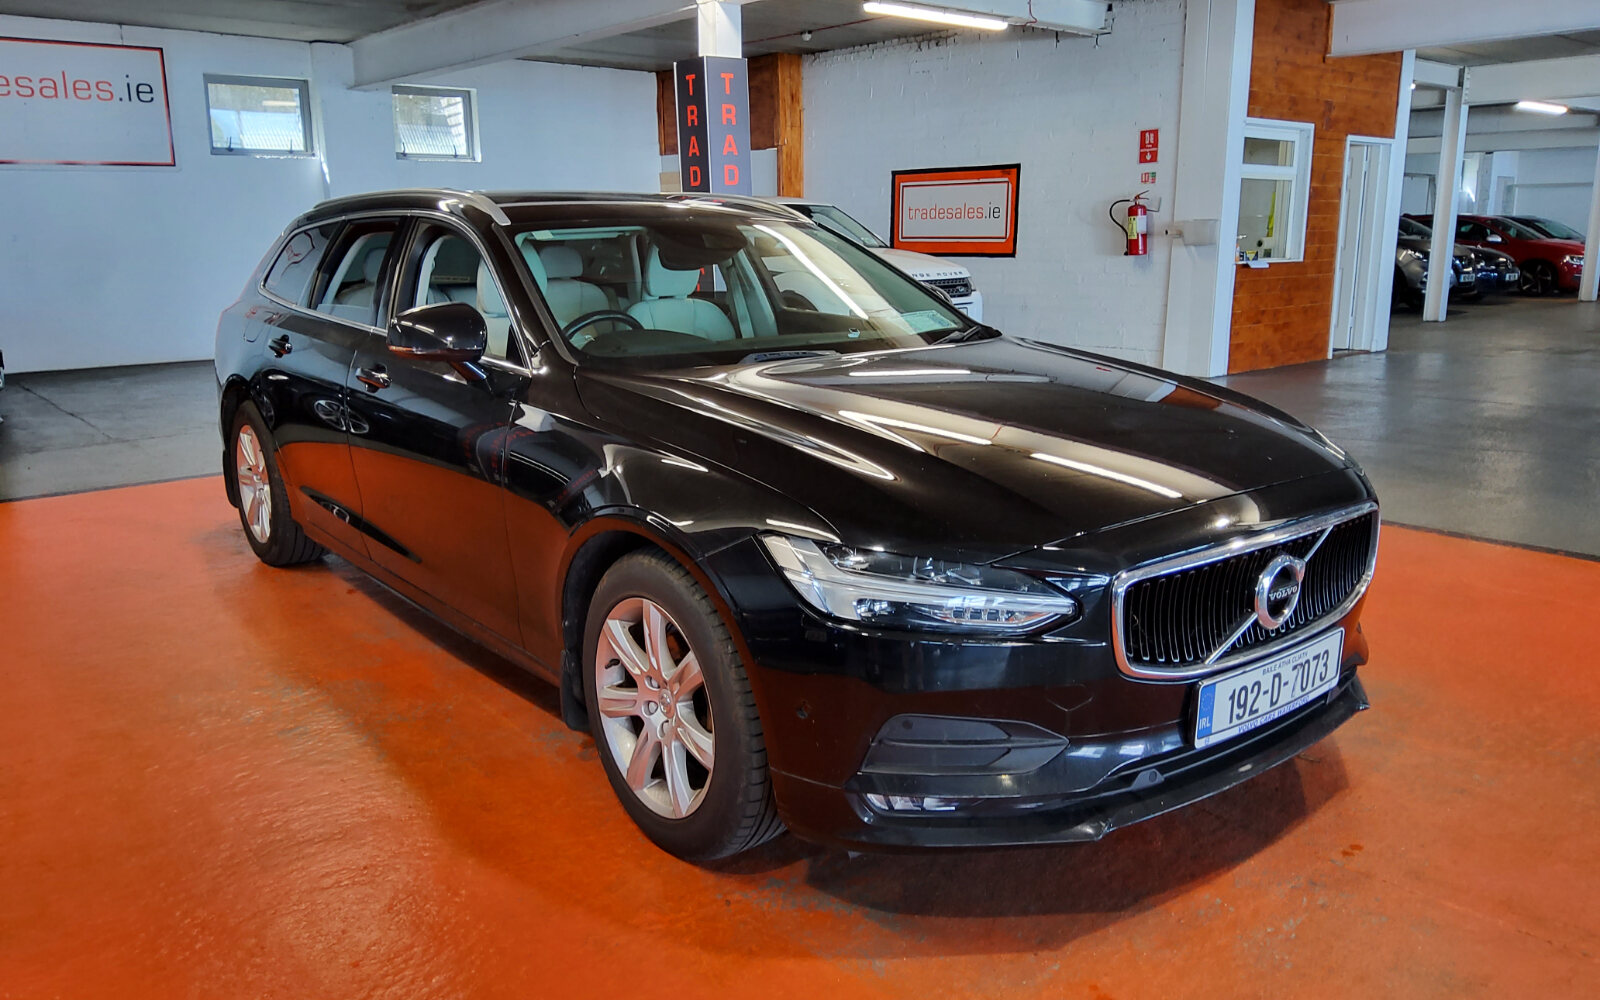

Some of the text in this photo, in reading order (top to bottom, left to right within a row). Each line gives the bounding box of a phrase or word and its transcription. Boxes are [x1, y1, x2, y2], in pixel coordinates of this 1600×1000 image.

[0, 70, 155, 103] esales.ie
[908, 202, 1000, 220] tradesales.ie
[1269, 585, 1298, 600] VOLVO
[1228, 649, 1329, 724] 192-D-7073
[1198, 716, 1211, 730] IRL
[1238, 719, 1259, 734] VOLVO
[1259, 711, 1276, 726] CARS
